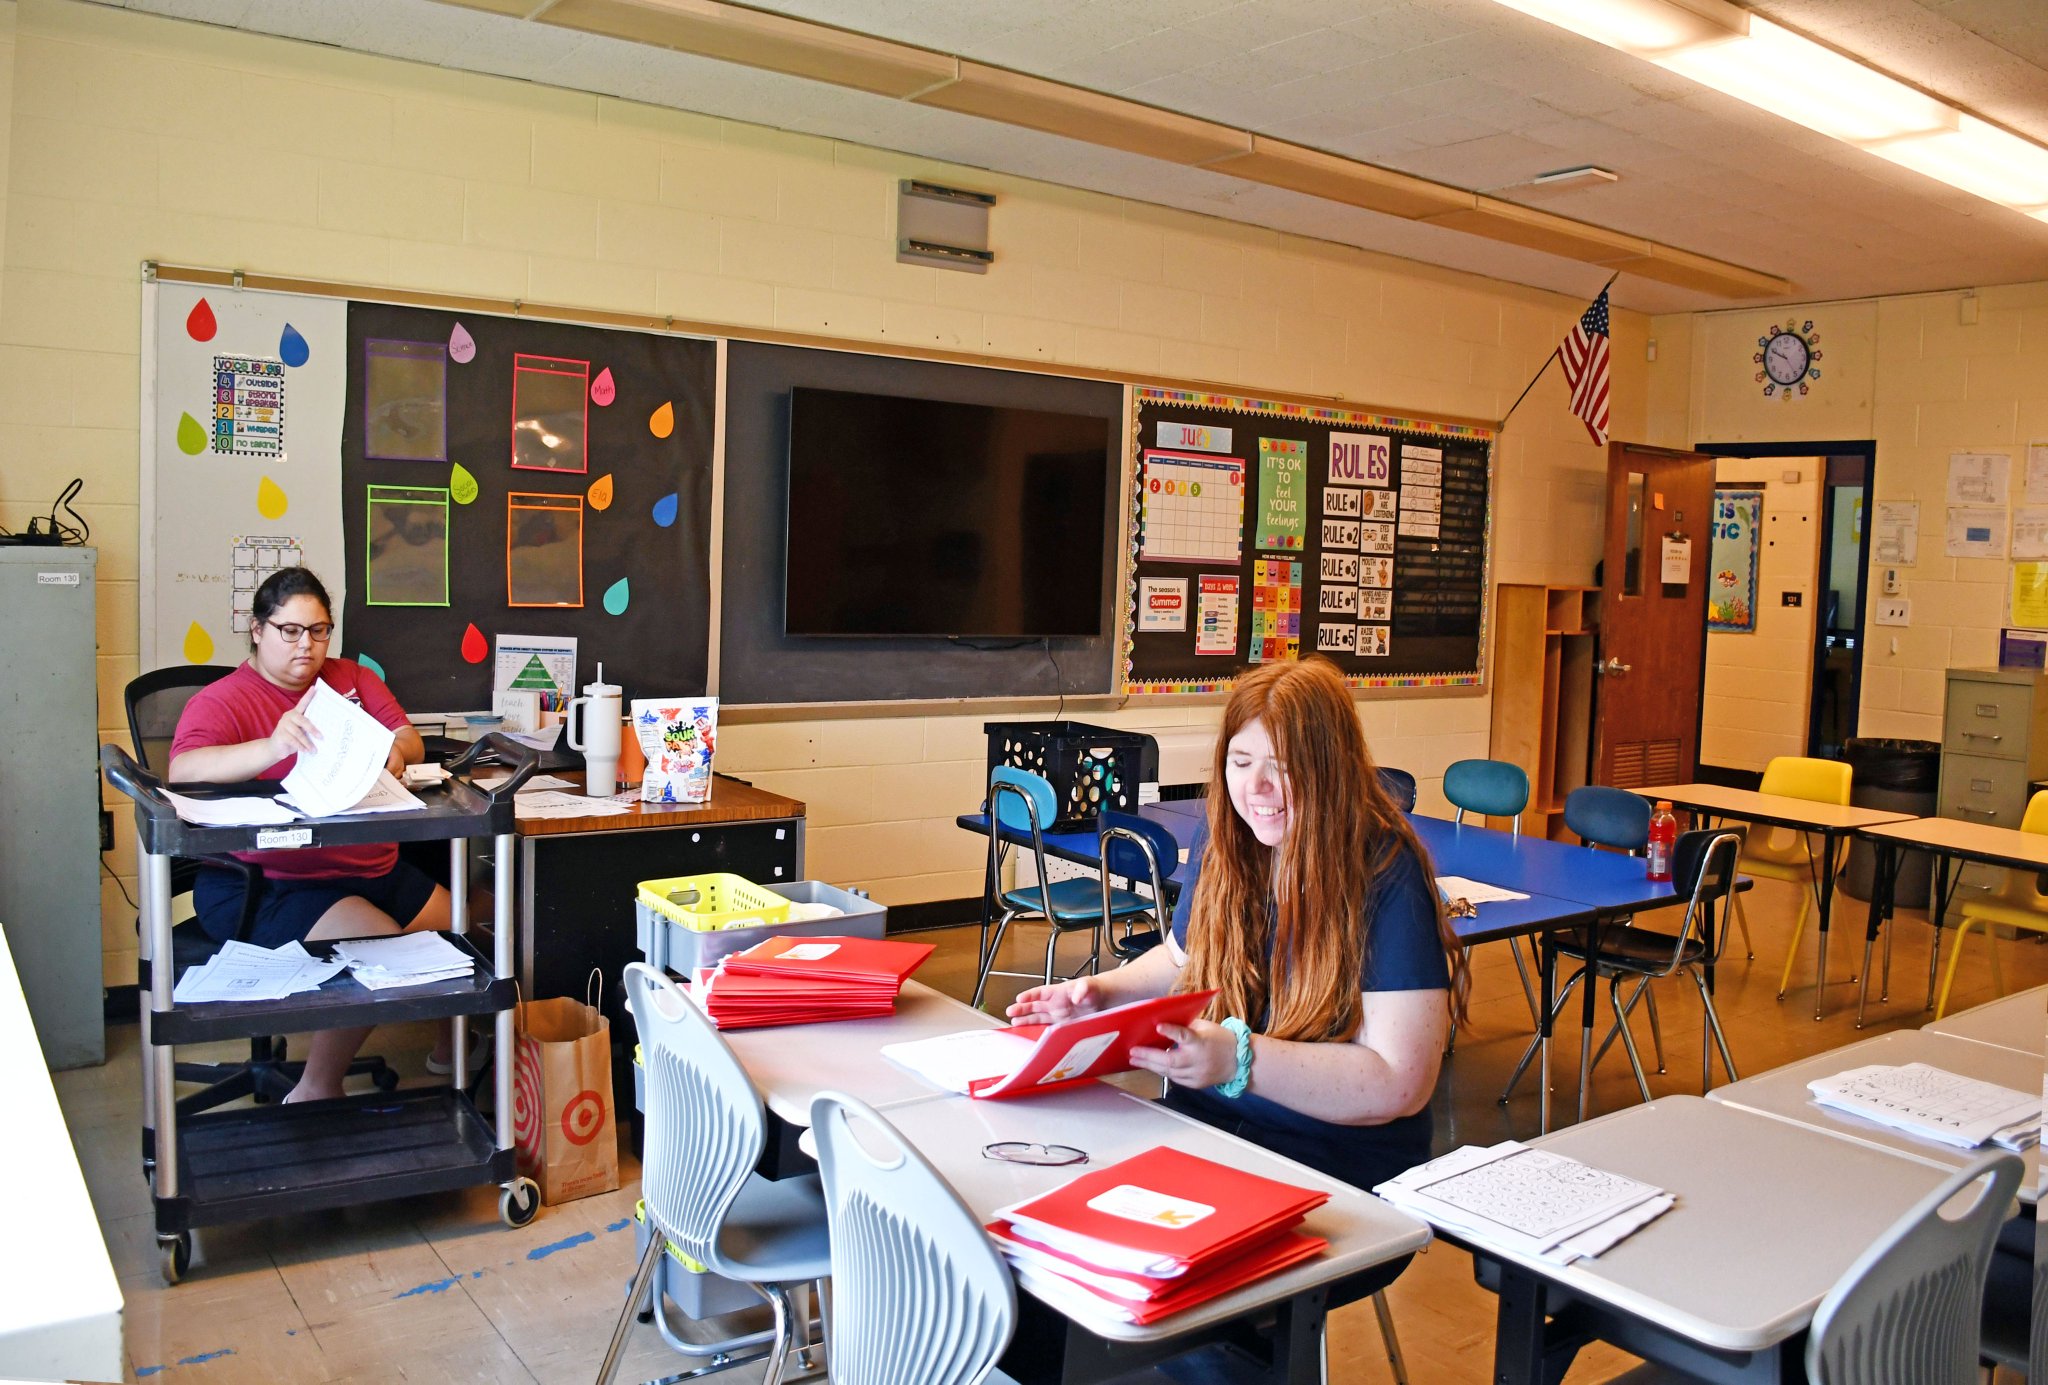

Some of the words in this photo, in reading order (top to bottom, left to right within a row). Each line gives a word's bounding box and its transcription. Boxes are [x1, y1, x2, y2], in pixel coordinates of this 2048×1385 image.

[221, 375, 231, 387] 4
[595, 384, 613, 394] Math
[221, 390, 230, 402] 3
[221, 407, 229, 418] 2
[221, 423, 228, 433] 1
[220, 438, 229, 448] 0
[1266, 456, 1285, 470] IT'S
[1287, 458, 1301, 471] OK
[1331, 443, 1387, 480] RULES
[1277, 471, 1290, 484] TO
[1276, 485, 1291, 498] feel
[1379, 492, 1390, 500] EARS
[1270, 499, 1297, 512] YOUR
[1326, 493, 1348, 512] RULE
[1380, 501, 1389, 509] ARE
[1373, 509, 1394, 519] LISTENING
[1720, 502, 1735, 519] IS
[1266, 513, 1299, 532] feelings
[1379, 525, 1390, 533] EYES
[1323, 525, 1345, 544] RULE
[1380, 534, 1389, 542] ARE
[1374, 543, 1393, 551] LOOKING
[1322, 558, 1344, 577] RULE
[1361, 558, 1377, 567] MOUTH
[1366, 567, 1371, 575] IS
[39, 575, 61, 583] Room
[1361, 576, 1375, 585] QUIET
[1151, 597, 1180, 607] Summer
[1321, 591, 1343, 609] RULE
[1361, 627, 1373, 636] RAISE
[1318, 628, 1341, 646] RULE
[1361, 637, 1372, 645] YOUR
[1360, 646, 1372, 654] HAND
[664, 729, 695, 741] SOUR
[260, 835, 288, 845] Room
[291, 832, 308, 842] 130
